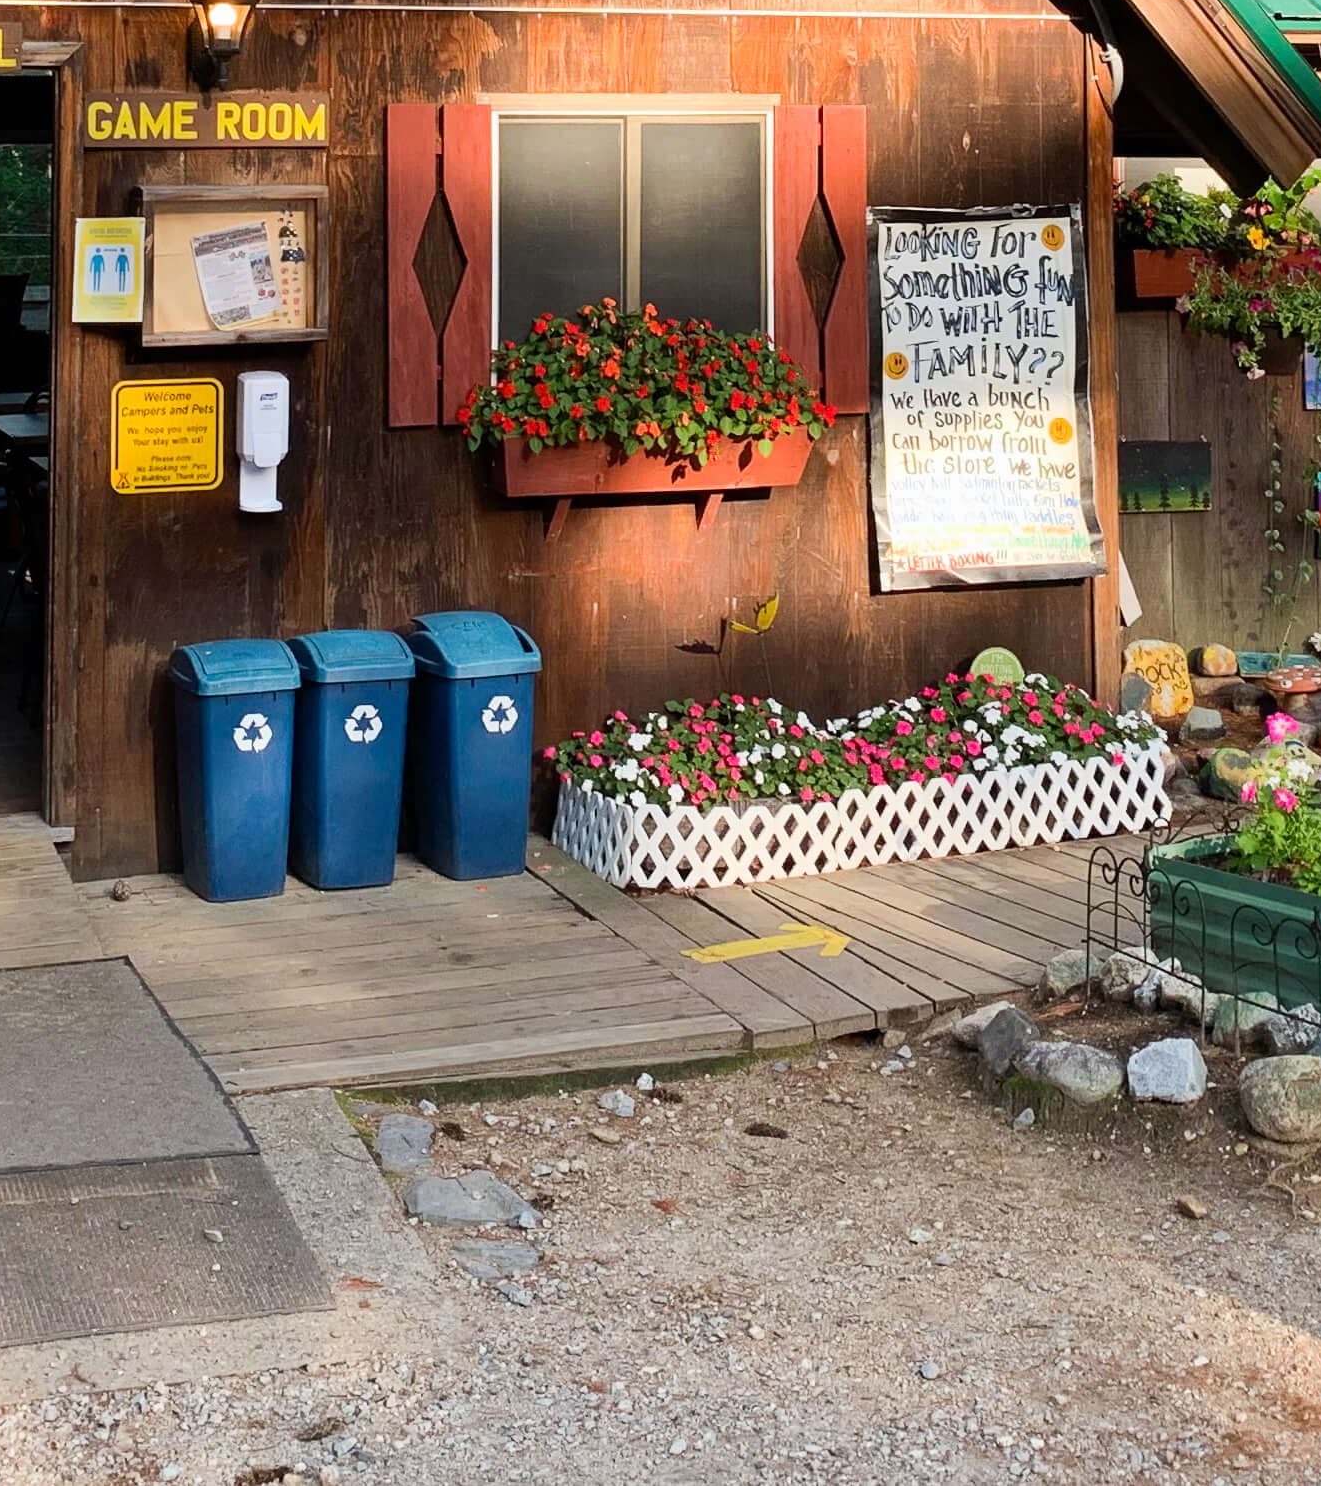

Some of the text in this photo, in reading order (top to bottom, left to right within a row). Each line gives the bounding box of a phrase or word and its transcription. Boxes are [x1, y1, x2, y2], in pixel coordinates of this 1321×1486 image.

[87, 101, 326, 141] GAME ROOM
[1007, 300, 1060, 339] THE
[144, 392, 192, 402] Welcome
[968, 391, 979, 407] a
[121, 404, 215, 418] Campers and Pets
[906, 410, 924, 428] of
[928, 430, 994, 453] borrow
